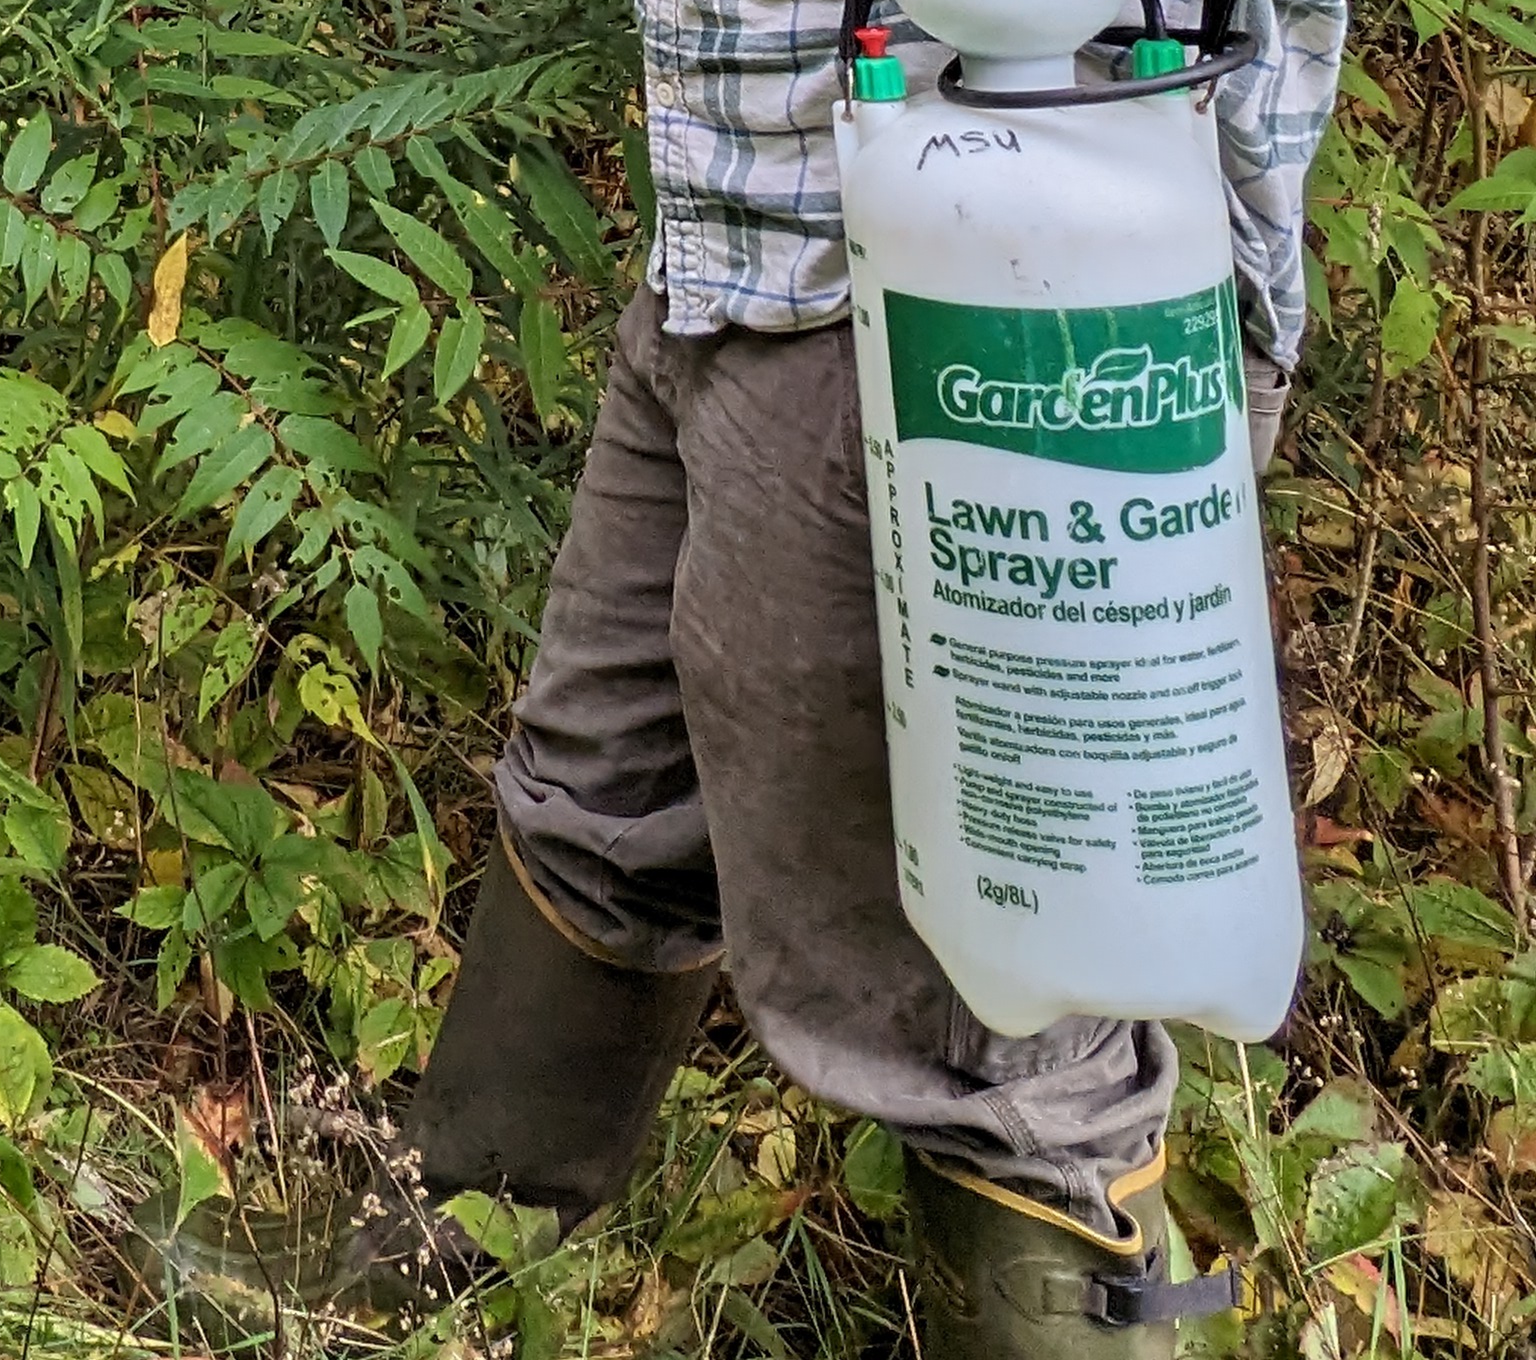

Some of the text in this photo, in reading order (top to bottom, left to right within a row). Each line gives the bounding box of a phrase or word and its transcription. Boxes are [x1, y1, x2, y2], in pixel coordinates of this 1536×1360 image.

[917, 129, 1021, 170] MSU
[938, 356, 1224, 430] GardenPlus
[924, 481, 1050, 543] Lawn
[1067, 500, 1106, 543] &
[884, 438, 914, 689] APPROXIMATE
[930, 528, 1119, 599] Sprayer
[933, 579, 1232, 627] Atomizador del césped y jardín
[989, 650, 1033, 663] purpose
[1089, 660, 1131, 670] sprayer
[1162, 656, 1176, 664] for
[1066, 672, 1088, 681] and
[1023, 685, 1047, 696] with
[1050, 688, 1108, 700] adjustable
[1111, 690, 1147, 700] nozzle
[1149, 689, 1170, 698] and
[1059, 748, 1080, 758] con
[1143, 734, 1150, 742] y
